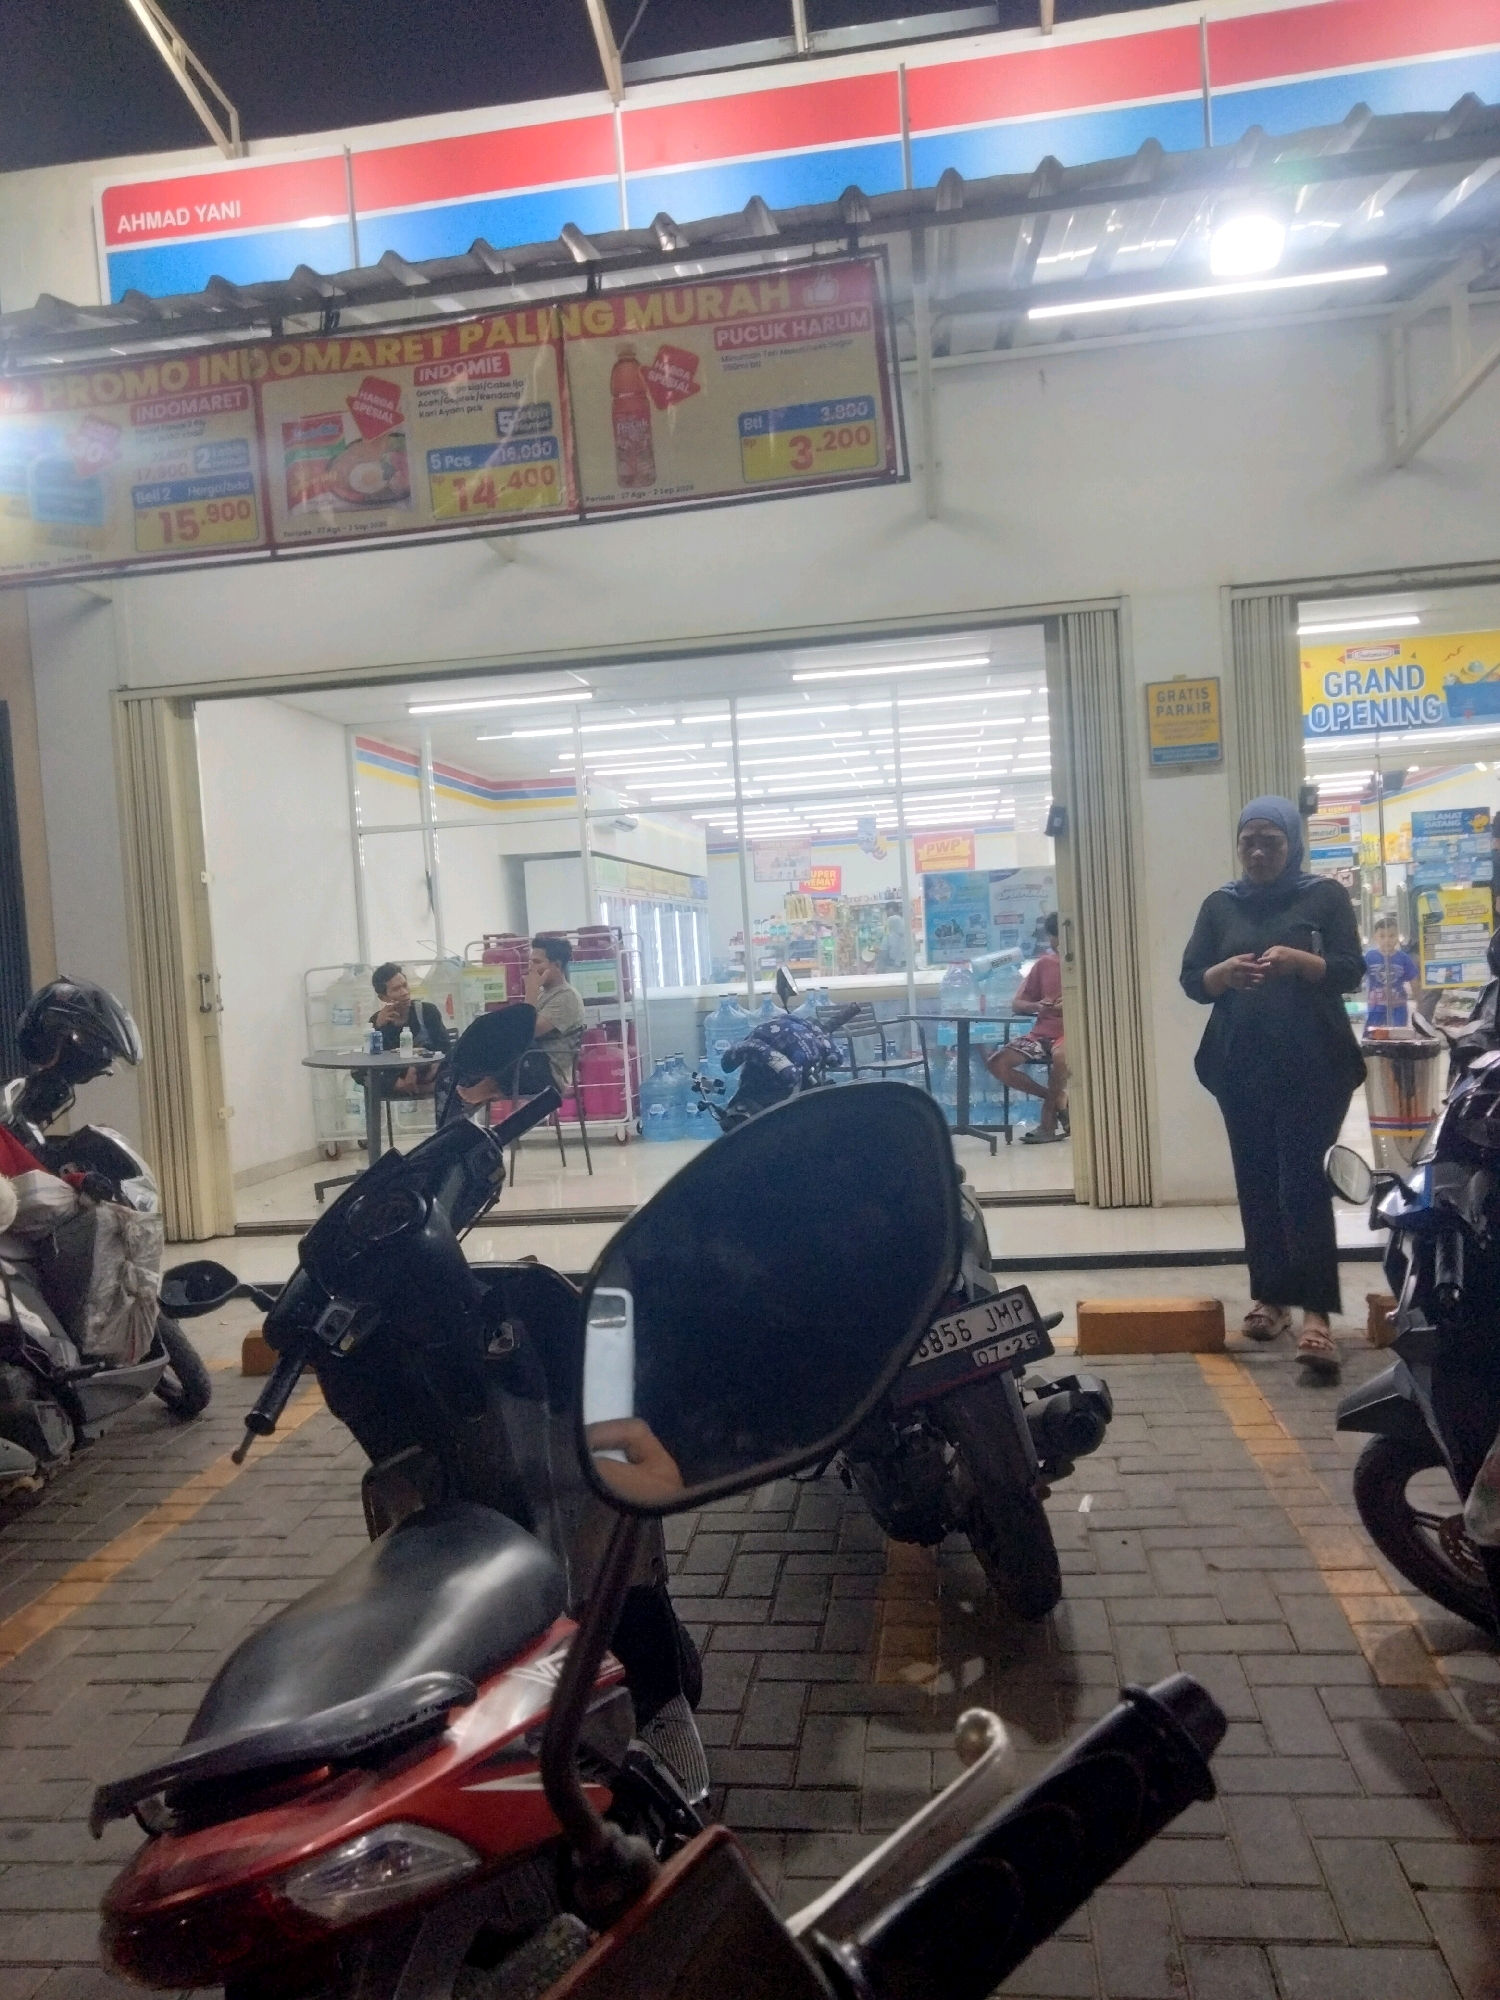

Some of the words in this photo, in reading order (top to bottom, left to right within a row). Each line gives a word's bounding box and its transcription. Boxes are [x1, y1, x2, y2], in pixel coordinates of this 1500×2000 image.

[117, 207, 191, 234] AHMAD
[194, 200, 242, 223] YANI
[41, 360, 190, 405] PROMO
[200, 329, 449, 385] INDOMARET
[459, 300, 614, 353] PALING
[624, 280, 791, 331] MURAH
[716, 321, 788, 347] PUCUK
[792, 310, 869, 338] HARUM
[419, 355, 503, 382] INDOMIE
[136, 391, 244, 423] INDOMARET
[438, 406, 465, 417] Ayam
[743, 415, 763, 431] Btl
[196, 448, 212, 469] 2
[430, 453, 442, 470] 5
[444, 455, 473, 469] Pcs
[788, 425, 872, 471] 3.200
[452, 464, 556, 512] 14.400
[158, 499, 251, 544] 15.900
[1157, 686, 1210, 703] GRATIS
[1324, 663, 1426, 698] GRAND
[1156, 701, 1212, 718] PARKIR
[1310, 693, 1443, 732] OPENING
[1425, 819, 1462, 828] DATANG
[926, 838, 961, 855] PWP
[984, 1298, 1024, 1333] JMP
